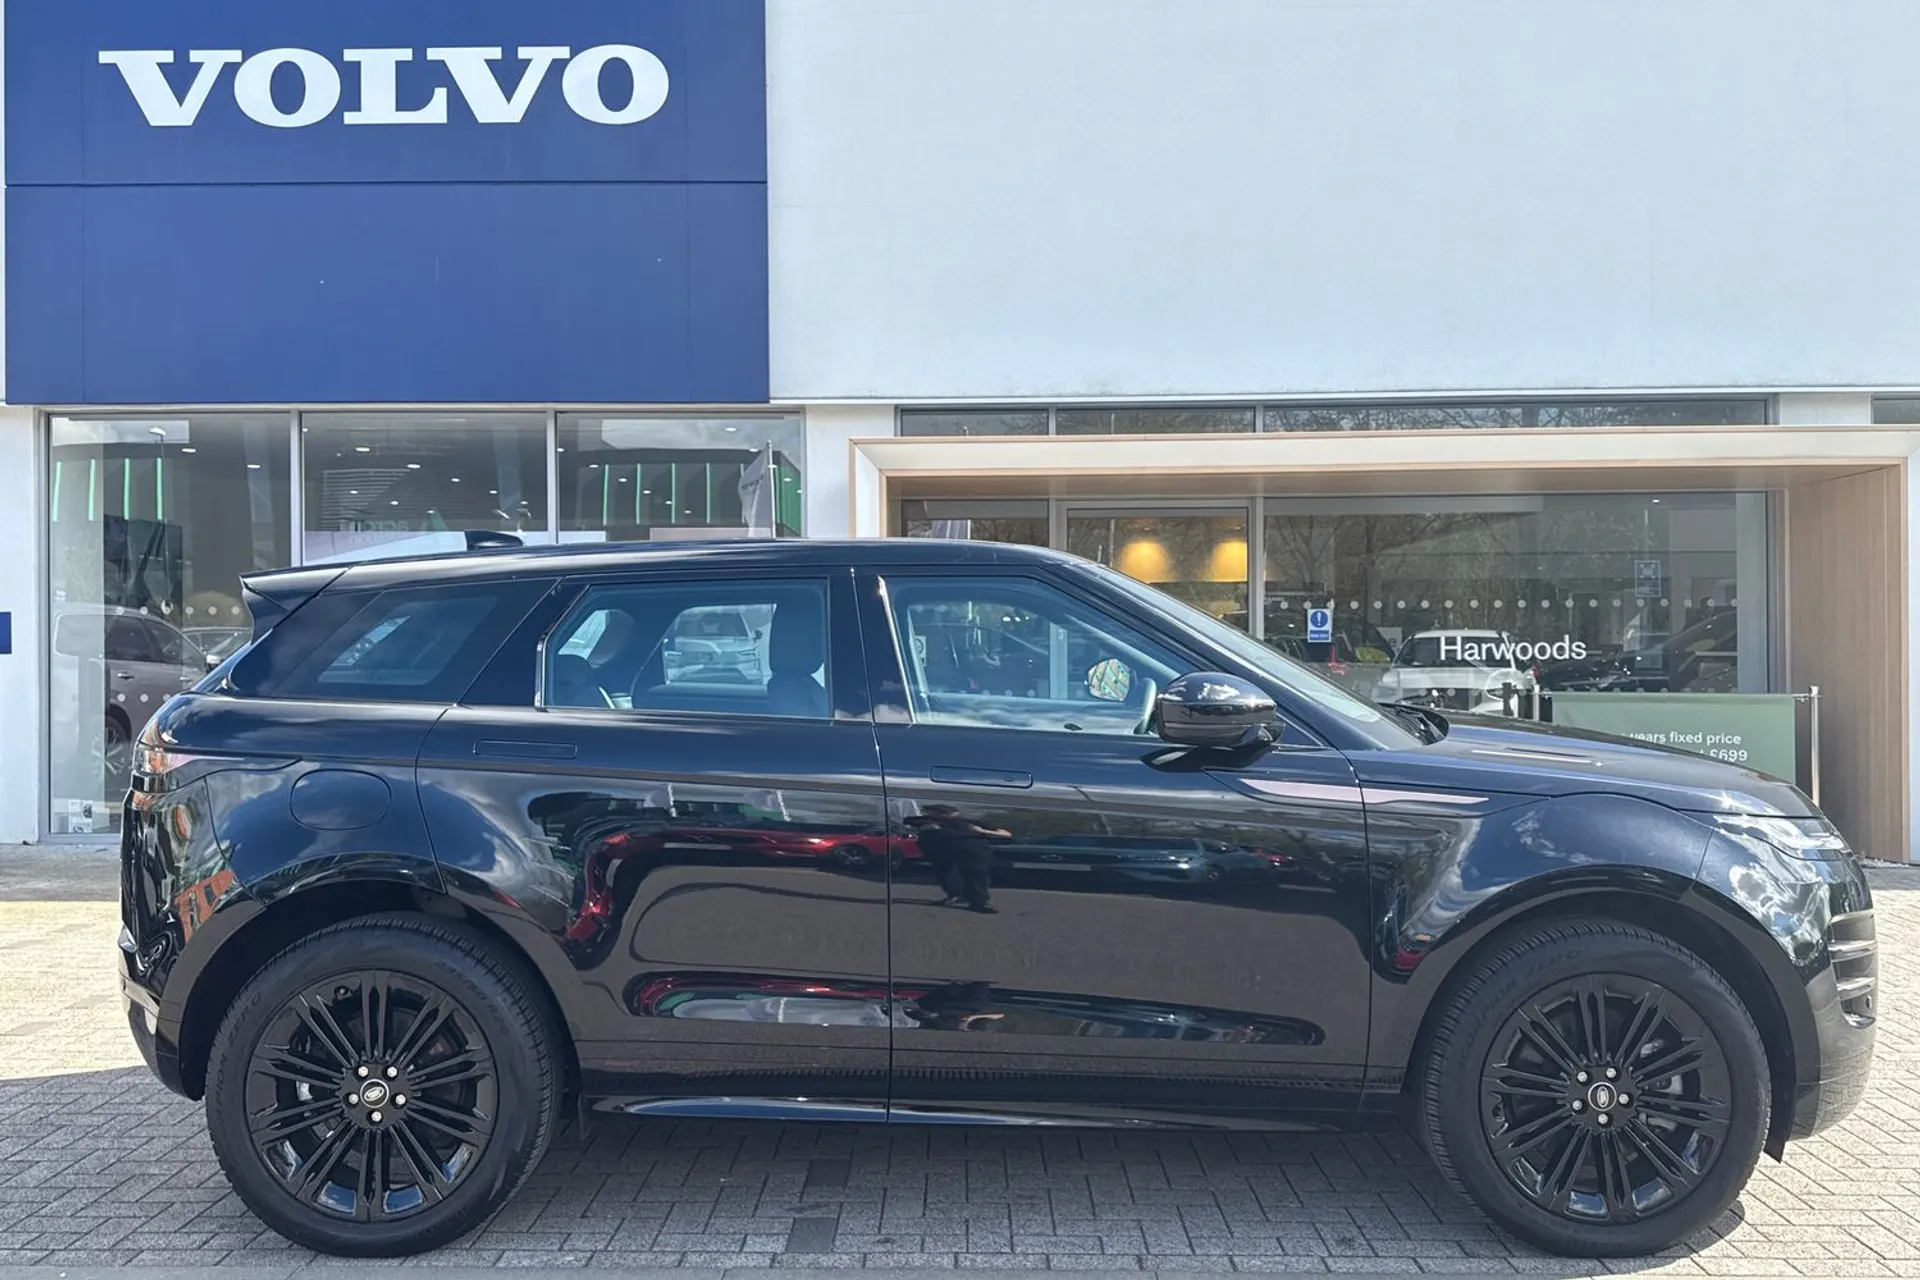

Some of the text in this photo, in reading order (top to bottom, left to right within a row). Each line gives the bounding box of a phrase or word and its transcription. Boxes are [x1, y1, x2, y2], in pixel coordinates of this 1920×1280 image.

[99, 44, 669, 127] VOLVO
[1439, 634, 1587, 661] Harwoods
[1669, 731, 1702, 743] fixed
[1706, 732, 1741, 745] price
